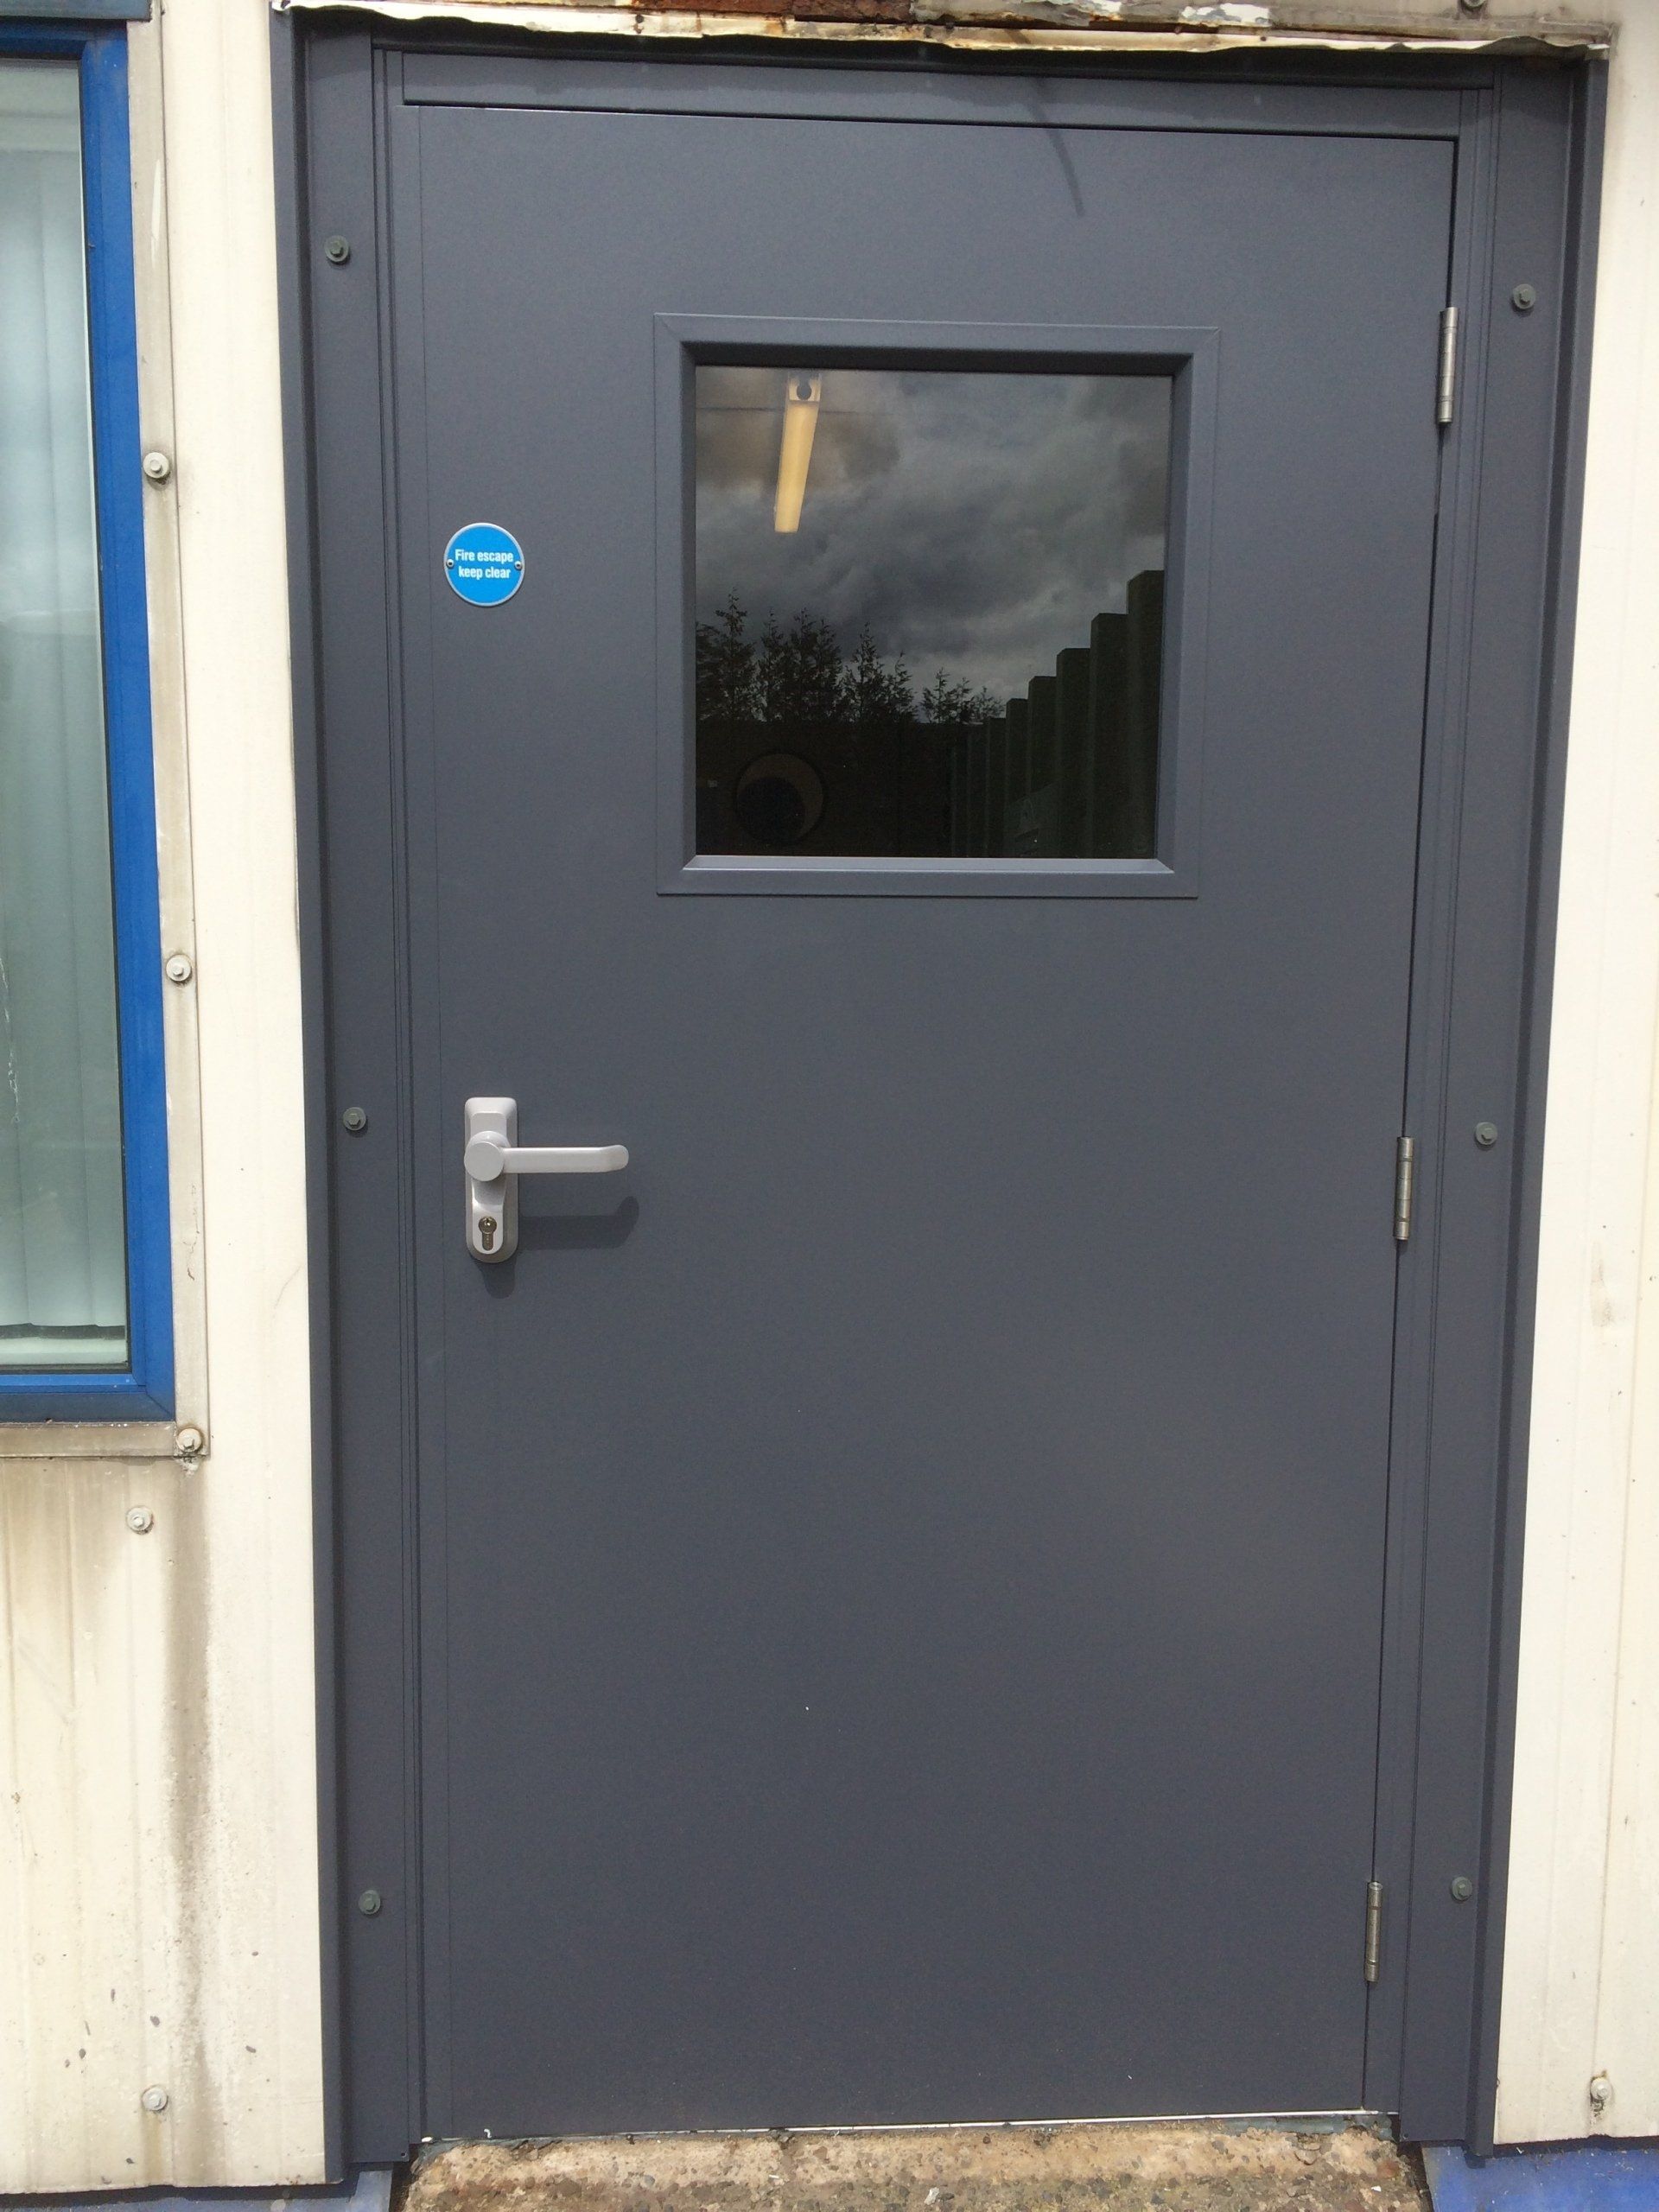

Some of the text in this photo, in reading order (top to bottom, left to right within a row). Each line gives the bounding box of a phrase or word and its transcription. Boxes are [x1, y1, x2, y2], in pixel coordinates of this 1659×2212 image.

[454, 548, 514, 564] Fire escape
[458, 566, 512, 581] keep clear
